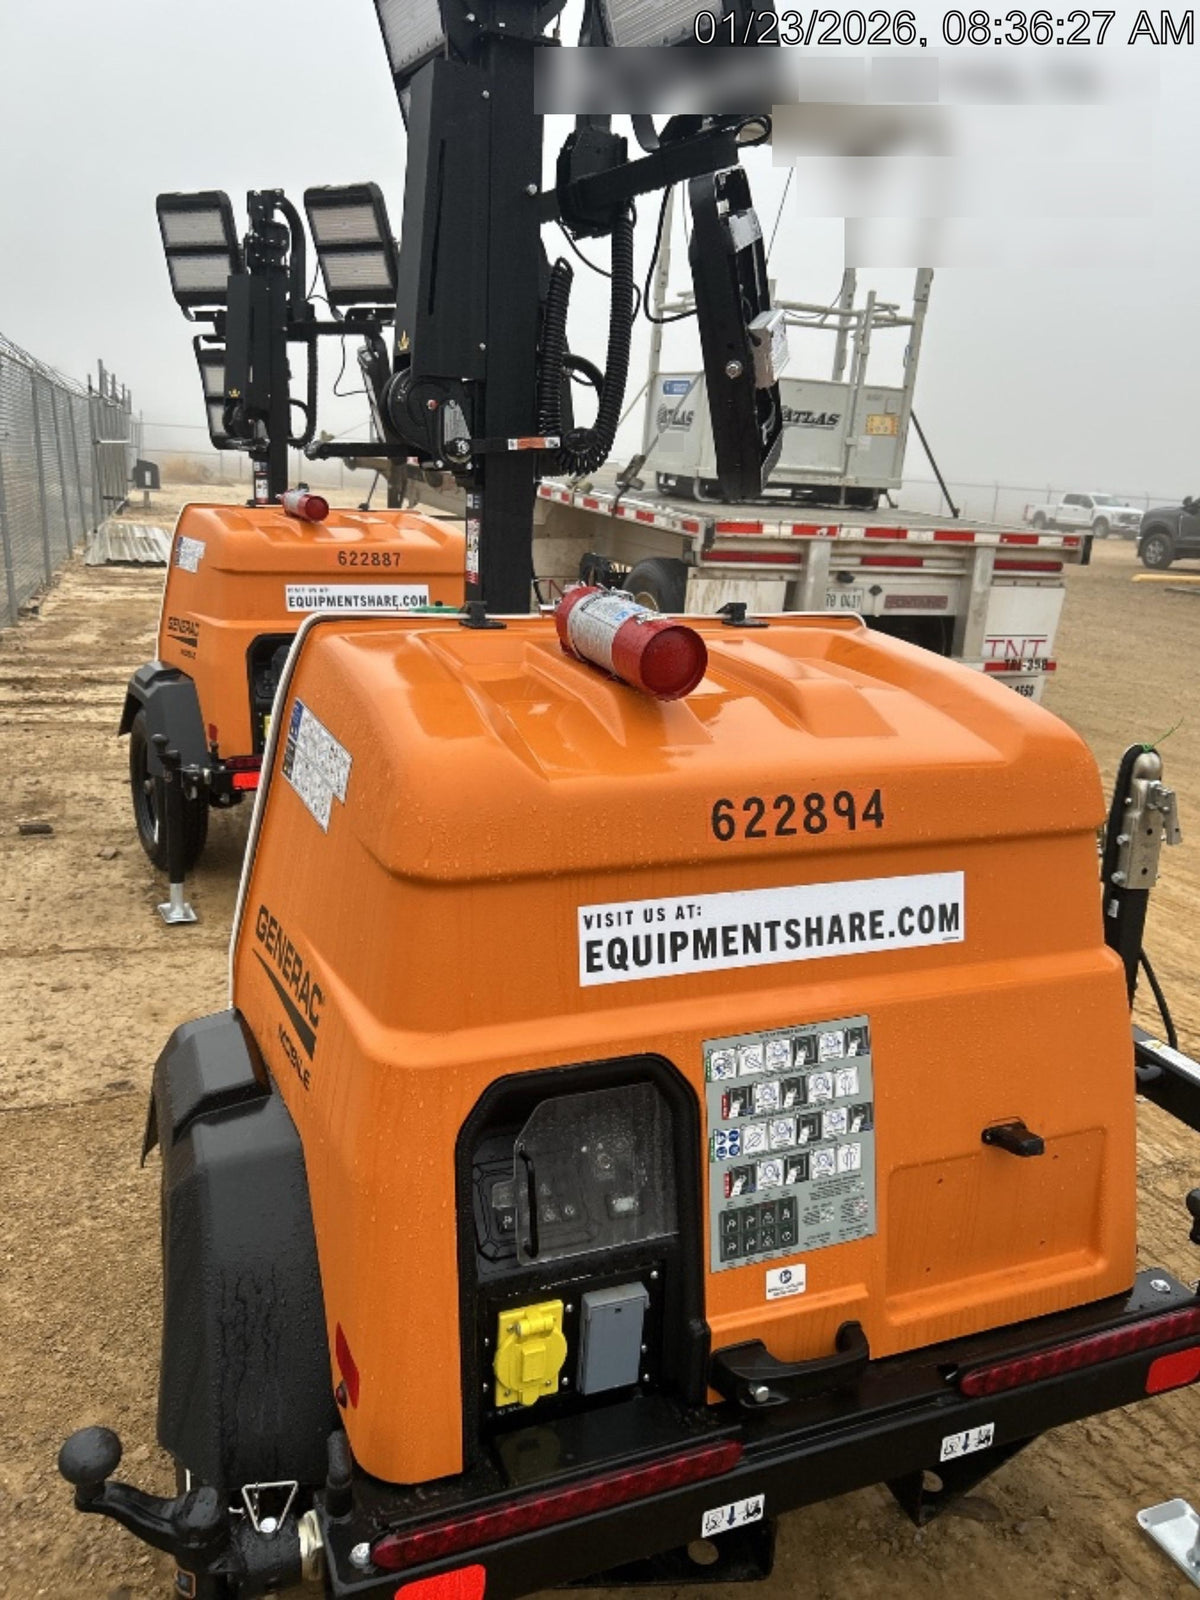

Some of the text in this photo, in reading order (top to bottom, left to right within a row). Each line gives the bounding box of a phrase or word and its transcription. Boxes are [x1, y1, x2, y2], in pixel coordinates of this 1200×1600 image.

[338, 551, 401, 567] 622887
[289, 594, 428, 608] EQUIPMENTSHARE.COM
[985, 639, 1047, 658] TNT
[711, 788, 884, 841] 622894
[583, 904, 702, 930] VISIT US AT:
[585, 902, 960, 974] EQUIPMENTSHARE.COM
[255, 904, 322, 1029] GENERAC
[278, 1023, 311, 1091] MOBILE
